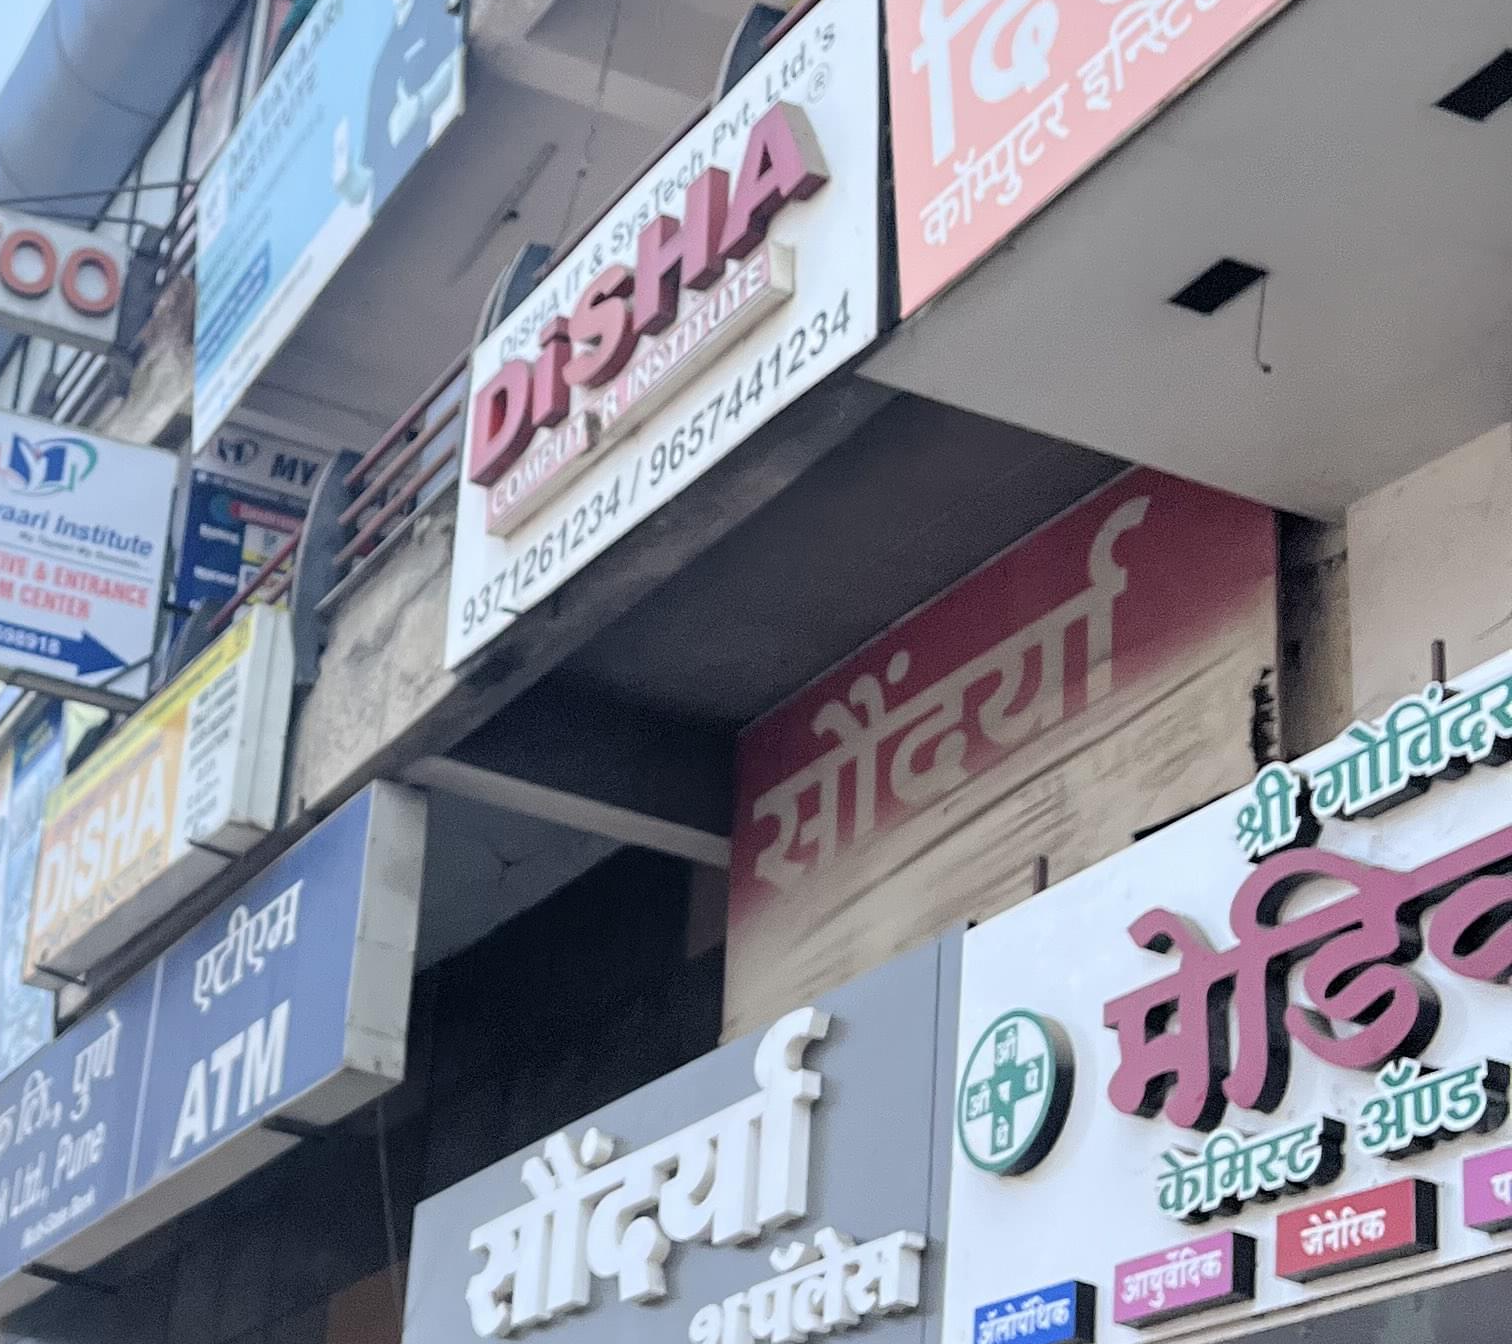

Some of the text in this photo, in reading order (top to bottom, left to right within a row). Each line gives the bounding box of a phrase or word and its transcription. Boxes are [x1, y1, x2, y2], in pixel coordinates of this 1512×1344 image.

[492, 254, 767, 515] COMPUTR INSTITUTE
[461, 476, 621, 637] 9371261234
[648, 287, 853, 488] 9657441234
[52, 514, 154, 558] Institute
[19, 584, 92, 621] CENTER
[52, 564, 149, 610] ENTRANCE
[1234, 762, 1299, 857] श्री
[192, 878, 305, 1015] एटीएम
[168, 998, 292, 1160] ATM
[51, 1120, 107, 1191] Pune
[1157, 1118, 1325, 1217] केमिस्ट
